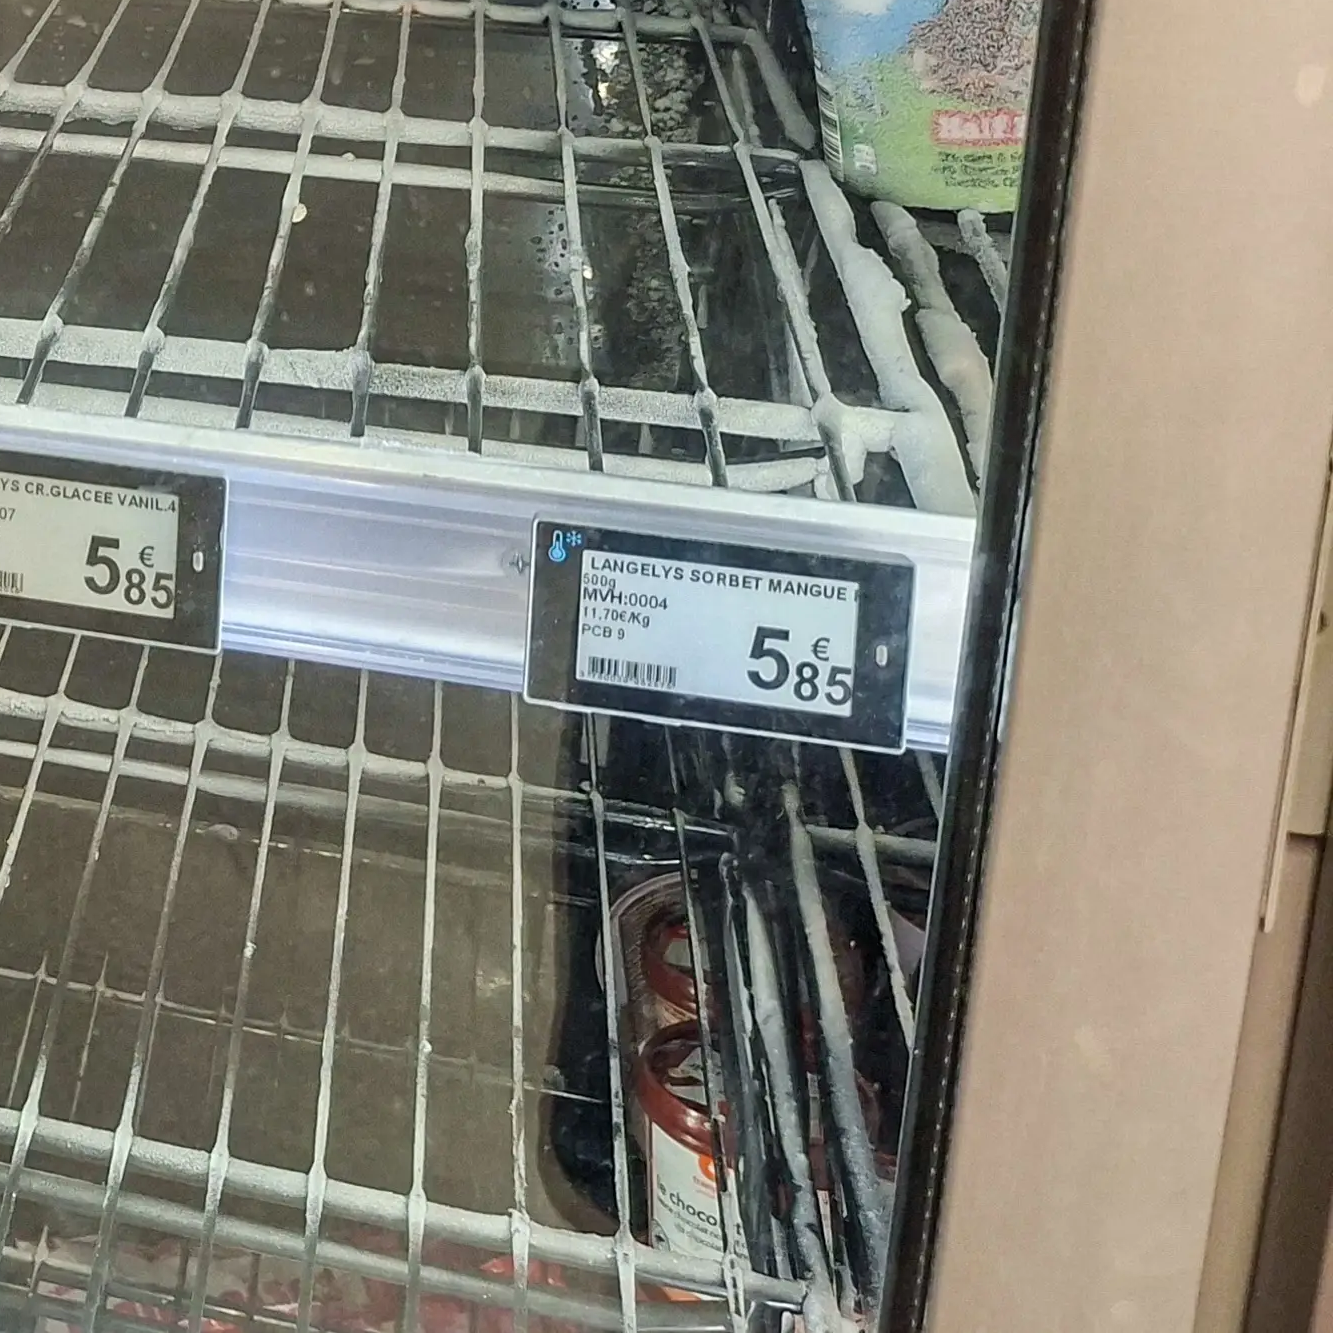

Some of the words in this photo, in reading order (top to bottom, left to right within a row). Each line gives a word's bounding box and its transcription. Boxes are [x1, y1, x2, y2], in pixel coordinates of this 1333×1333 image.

[24, 482, 114, 505] CR.GLACEE
[117, 493, 177, 513] VANIL.4
[84, 535, 121, 595] 5
[138, 545, 155, 568] €
[123, 568, 174, 609] 85
[583, 573, 617, 591] 500g
[590, 556, 684, 581] LANGELYS
[689, 568, 764, 591] SORBET
[768, 577, 848, 601] MANGUE
[583, 587, 669, 611] MVH:0004
[581, 623, 612, 639] PCB
[617, 627, 626, 641] 9
[746, 625, 791, 691] 5
[810, 637, 831, 662] €
[793, 661, 853, 706] 85
